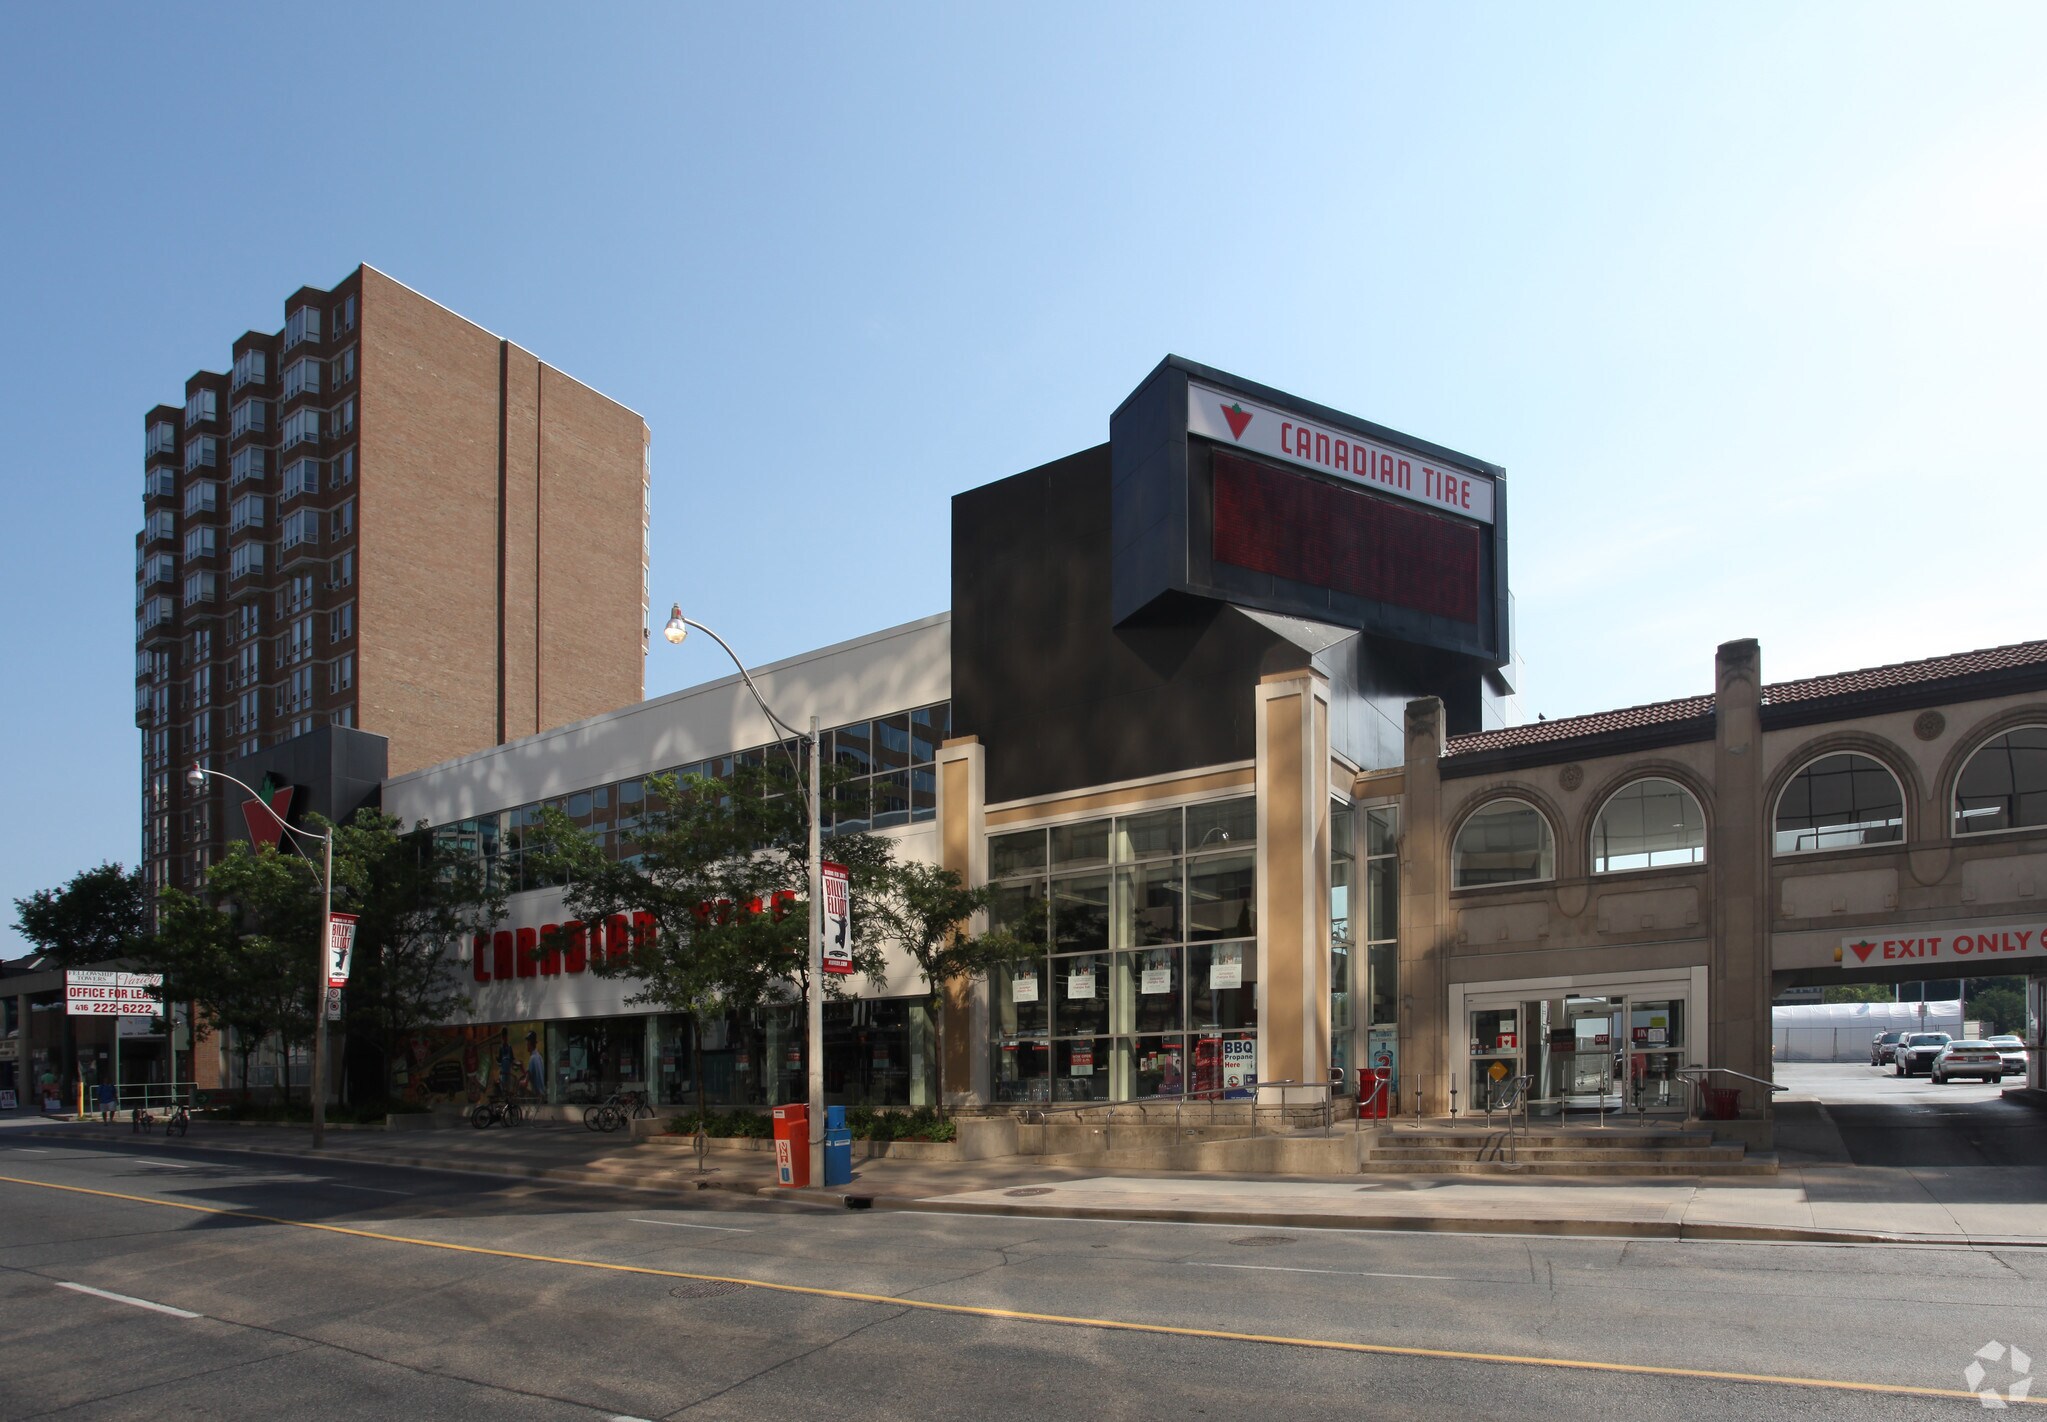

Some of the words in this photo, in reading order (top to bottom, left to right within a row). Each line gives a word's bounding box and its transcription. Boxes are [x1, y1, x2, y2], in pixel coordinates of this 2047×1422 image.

[1281, 422, 1411, 491] CANADIAN
[1422, 466, 1471, 510] TIRE
[826, 878, 843, 897] BILLY
[827, 896, 847, 917] ELLIOT
[332, 924, 349, 937] BILLY
[332, 937, 351, 948] ELLIOT
[1883, 937, 1942, 960] EXIT
[1952, 930, 2034, 955] ONLY
[69, 987, 105, 998] OFFICE
[109, 988, 128, 999] FOR
[93, 1003, 152, 1013] 222-6222
[1637, 1028, 1647, 1038] IN
[1224, 1041, 1253, 1053] BBQ
